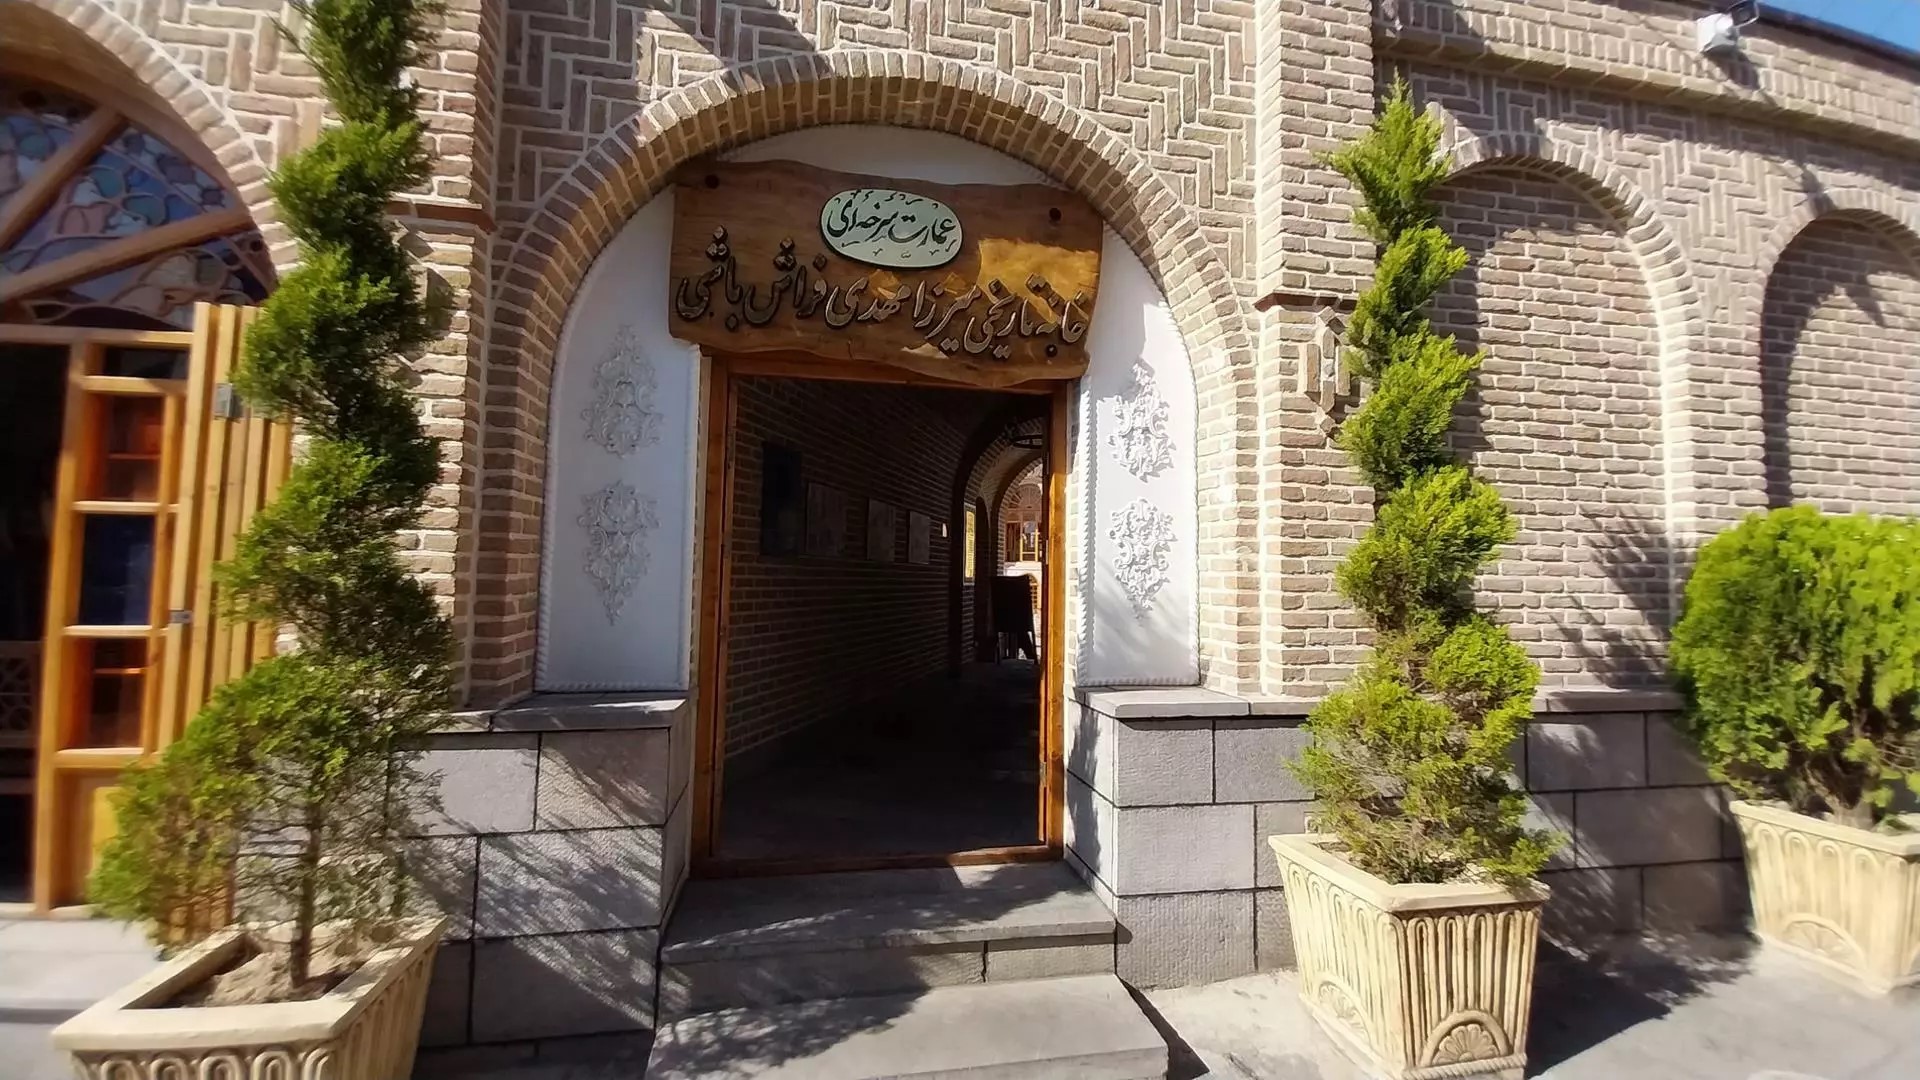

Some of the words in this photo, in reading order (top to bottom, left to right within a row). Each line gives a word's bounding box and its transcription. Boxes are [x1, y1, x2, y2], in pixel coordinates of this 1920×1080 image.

[888, 214, 957, 247] عمارت
[675, 225, 743, 332] باشی
[743, 237, 828, 325] فراش
[825, 276, 911, 327] مهدی
[914, 279, 981, 352] میرزا
[963, 272, 1047, 359] تاریخی
[1035, 290, 1088, 357] خانه
